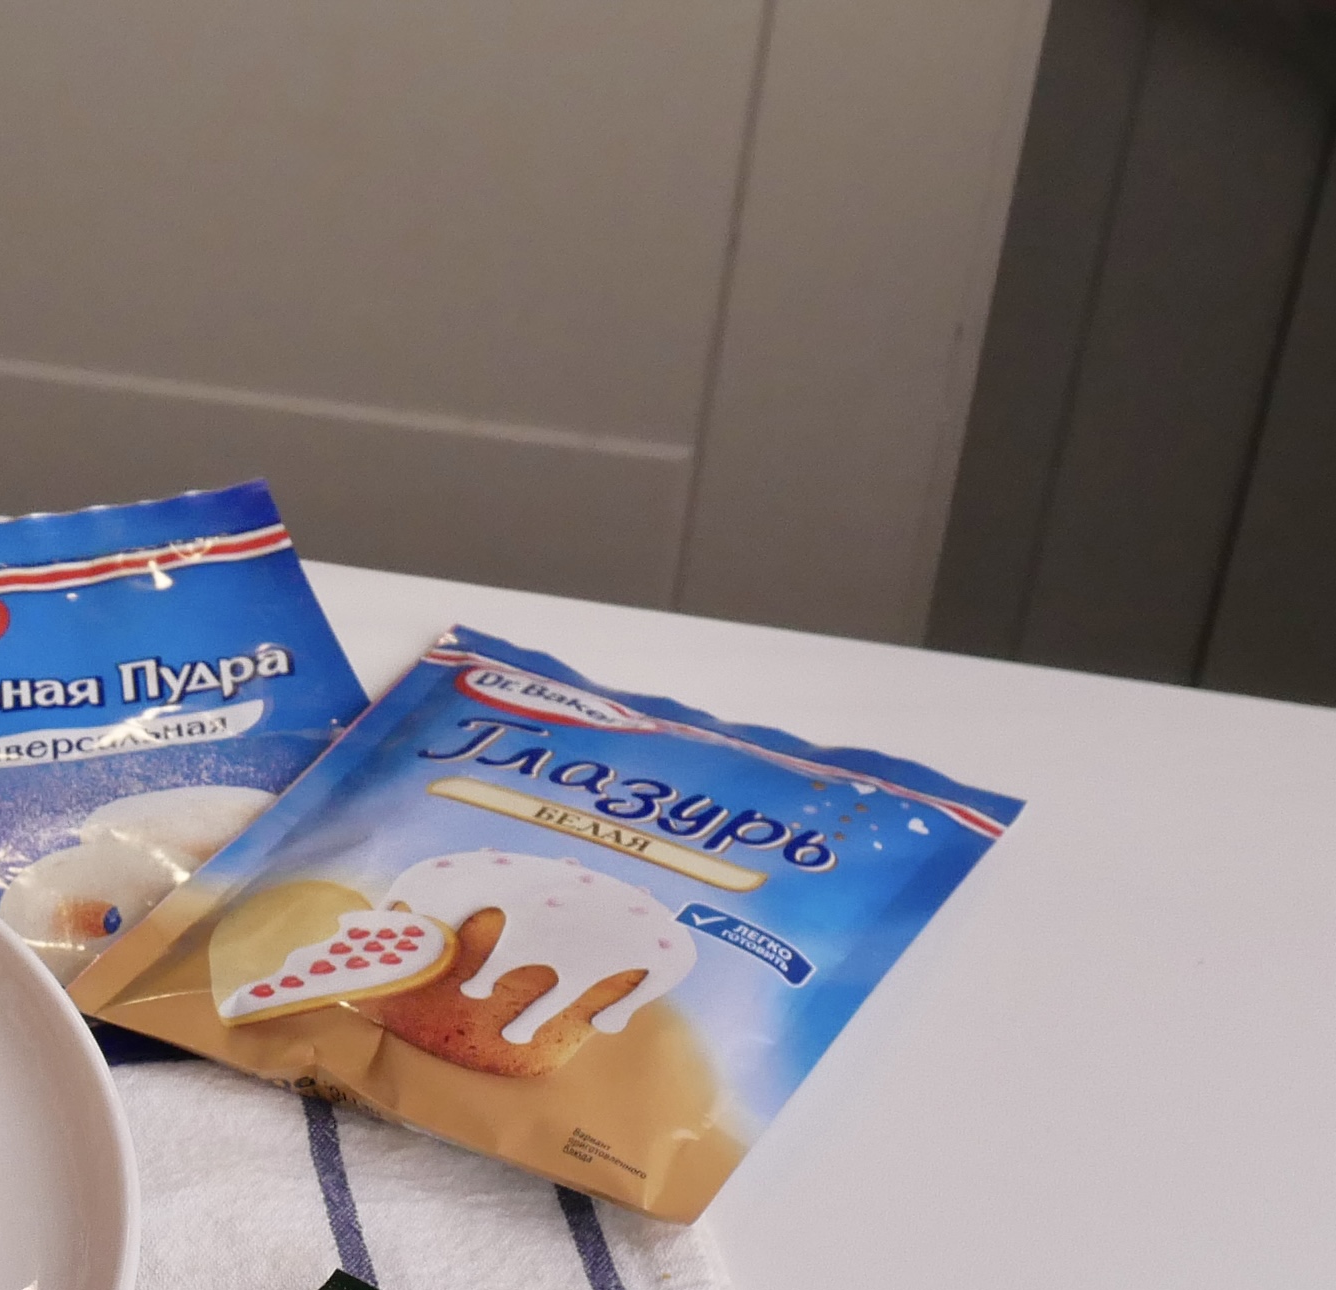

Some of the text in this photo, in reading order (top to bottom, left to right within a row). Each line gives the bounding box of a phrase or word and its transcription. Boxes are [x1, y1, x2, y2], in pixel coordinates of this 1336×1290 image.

[117, 644, 294, 704] Пудра
[417, 717, 837, 873] Глазурь
[532, 804, 652, 855] БЕЛАЯ
[721, 929, 789, 972] ГОТОВИТЬ
[733, 924, 793, 961] ЛЕГКО
